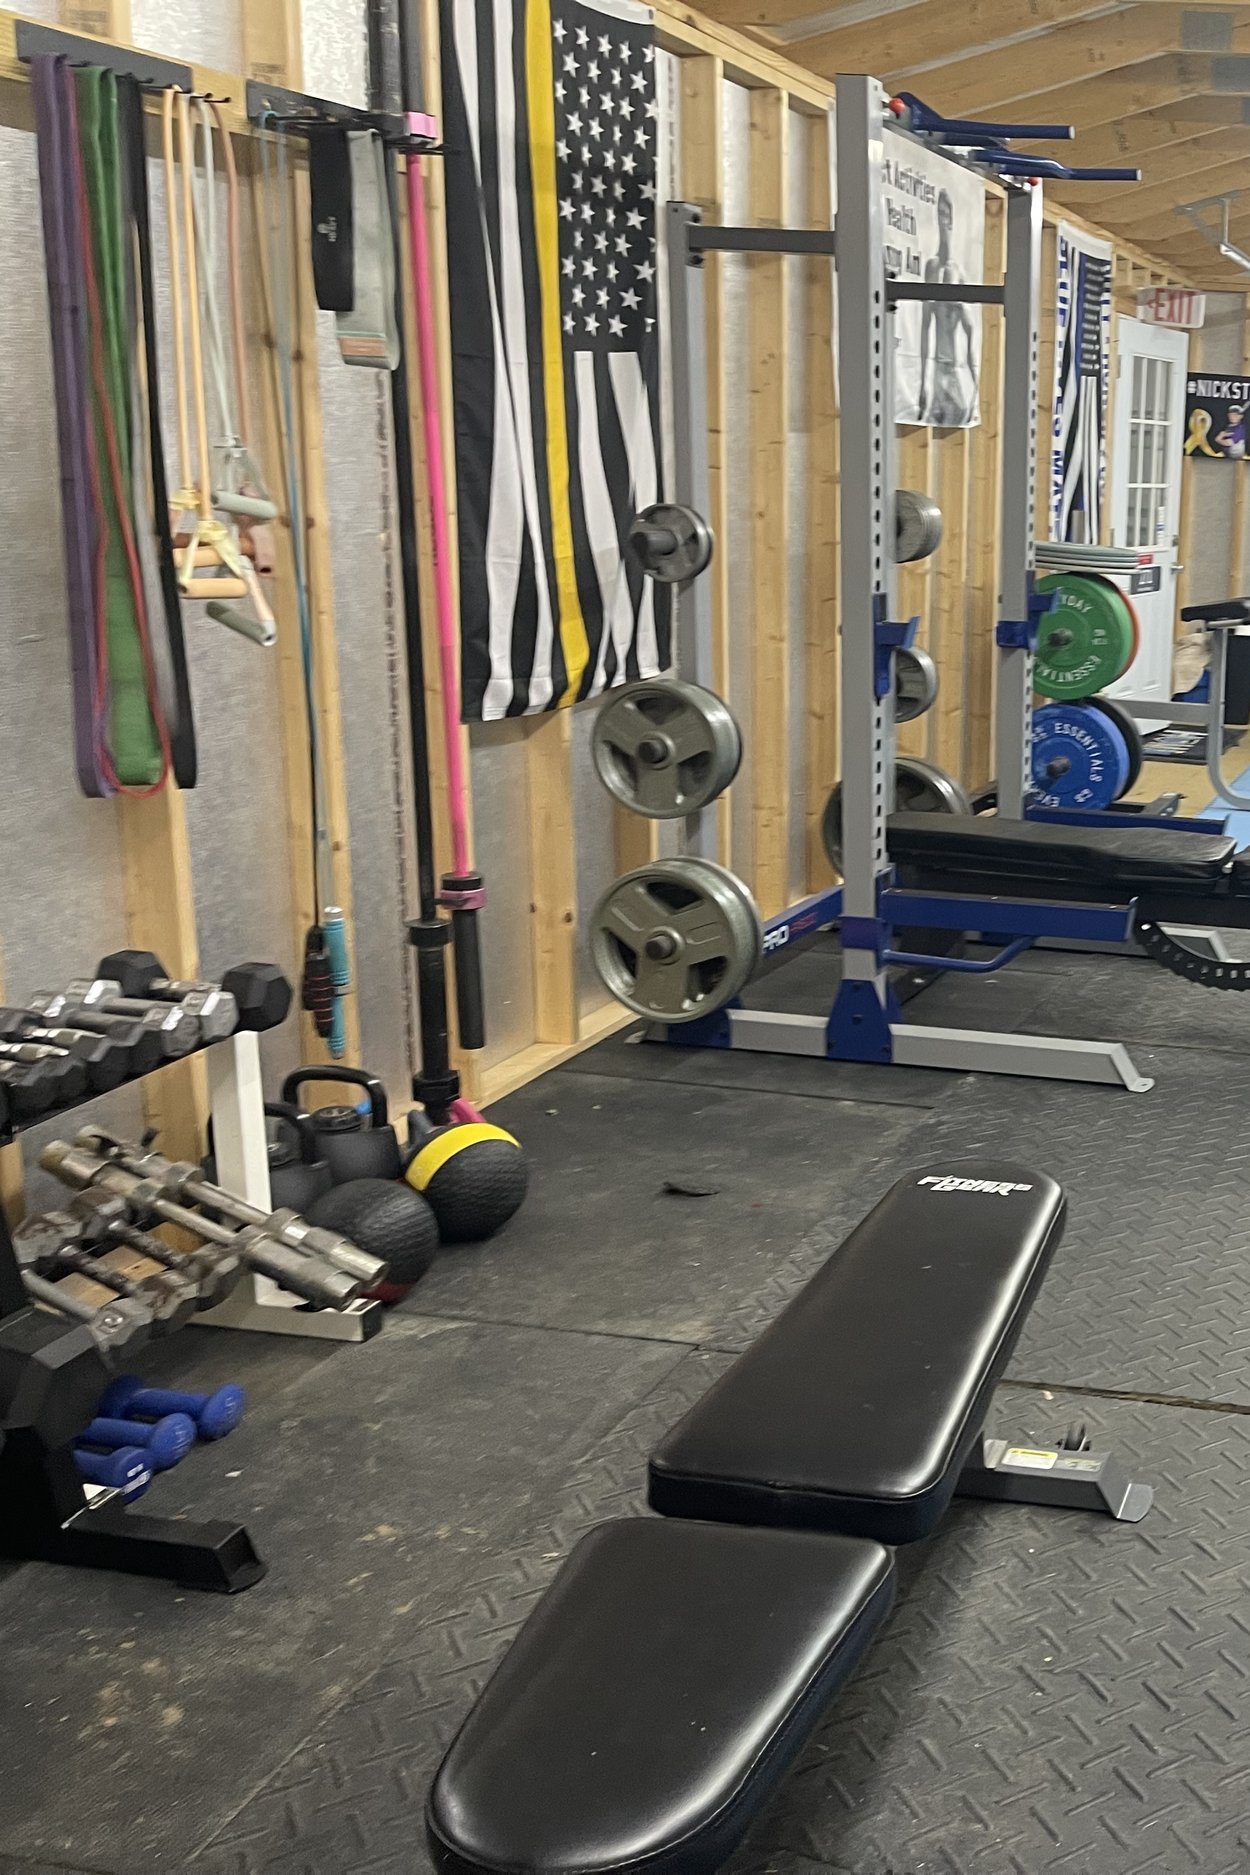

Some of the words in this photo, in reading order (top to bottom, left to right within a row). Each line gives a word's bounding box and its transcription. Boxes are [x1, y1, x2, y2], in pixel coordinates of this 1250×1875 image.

[1153, 287, 1198, 325] EXIT
[1054, 722, 1104, 782] ESSENTIALS
[762, 924, 790, 954] PRO
